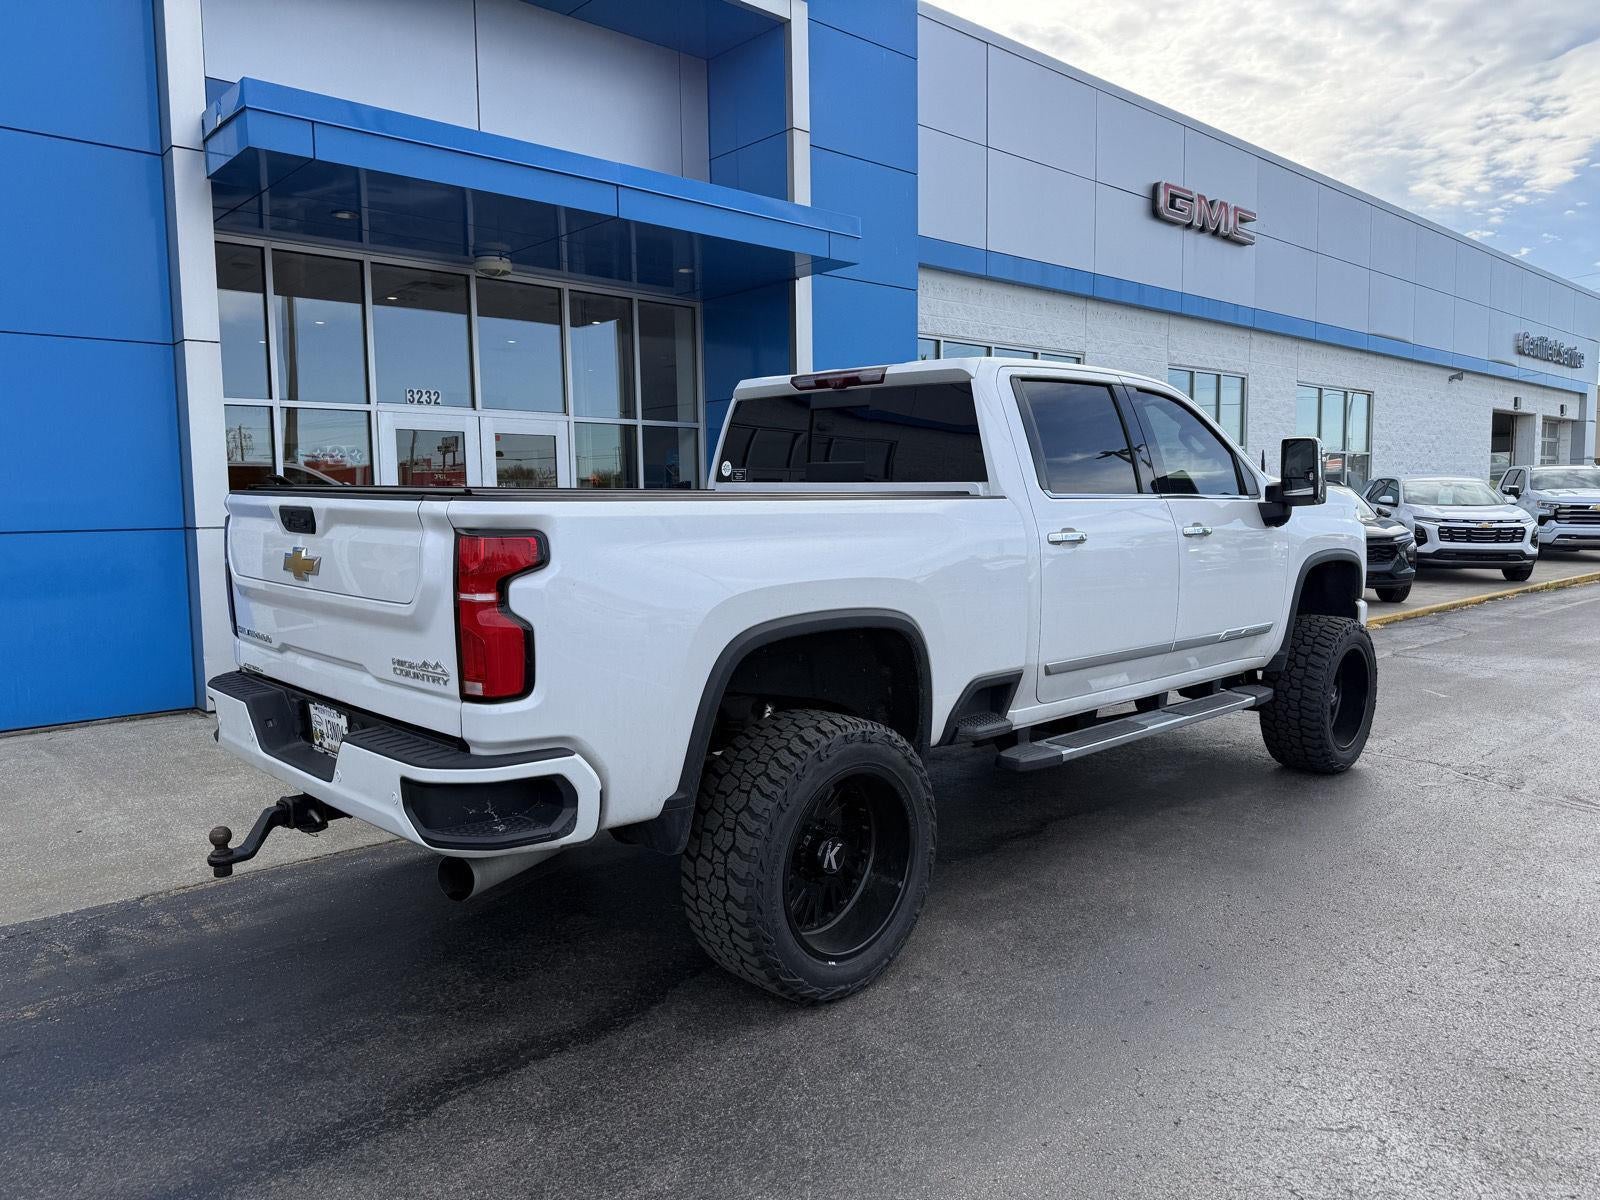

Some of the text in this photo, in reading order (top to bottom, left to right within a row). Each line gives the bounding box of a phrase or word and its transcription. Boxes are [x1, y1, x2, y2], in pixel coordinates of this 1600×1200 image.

[1152, 181, 1257, 246] GMC
[1515, 331, 1585, 368] Certified Service
[407, 389, 441, 406] 3232
[392, 666, 450, 686] COUNTRY
[823, 842, 843, 869] K
